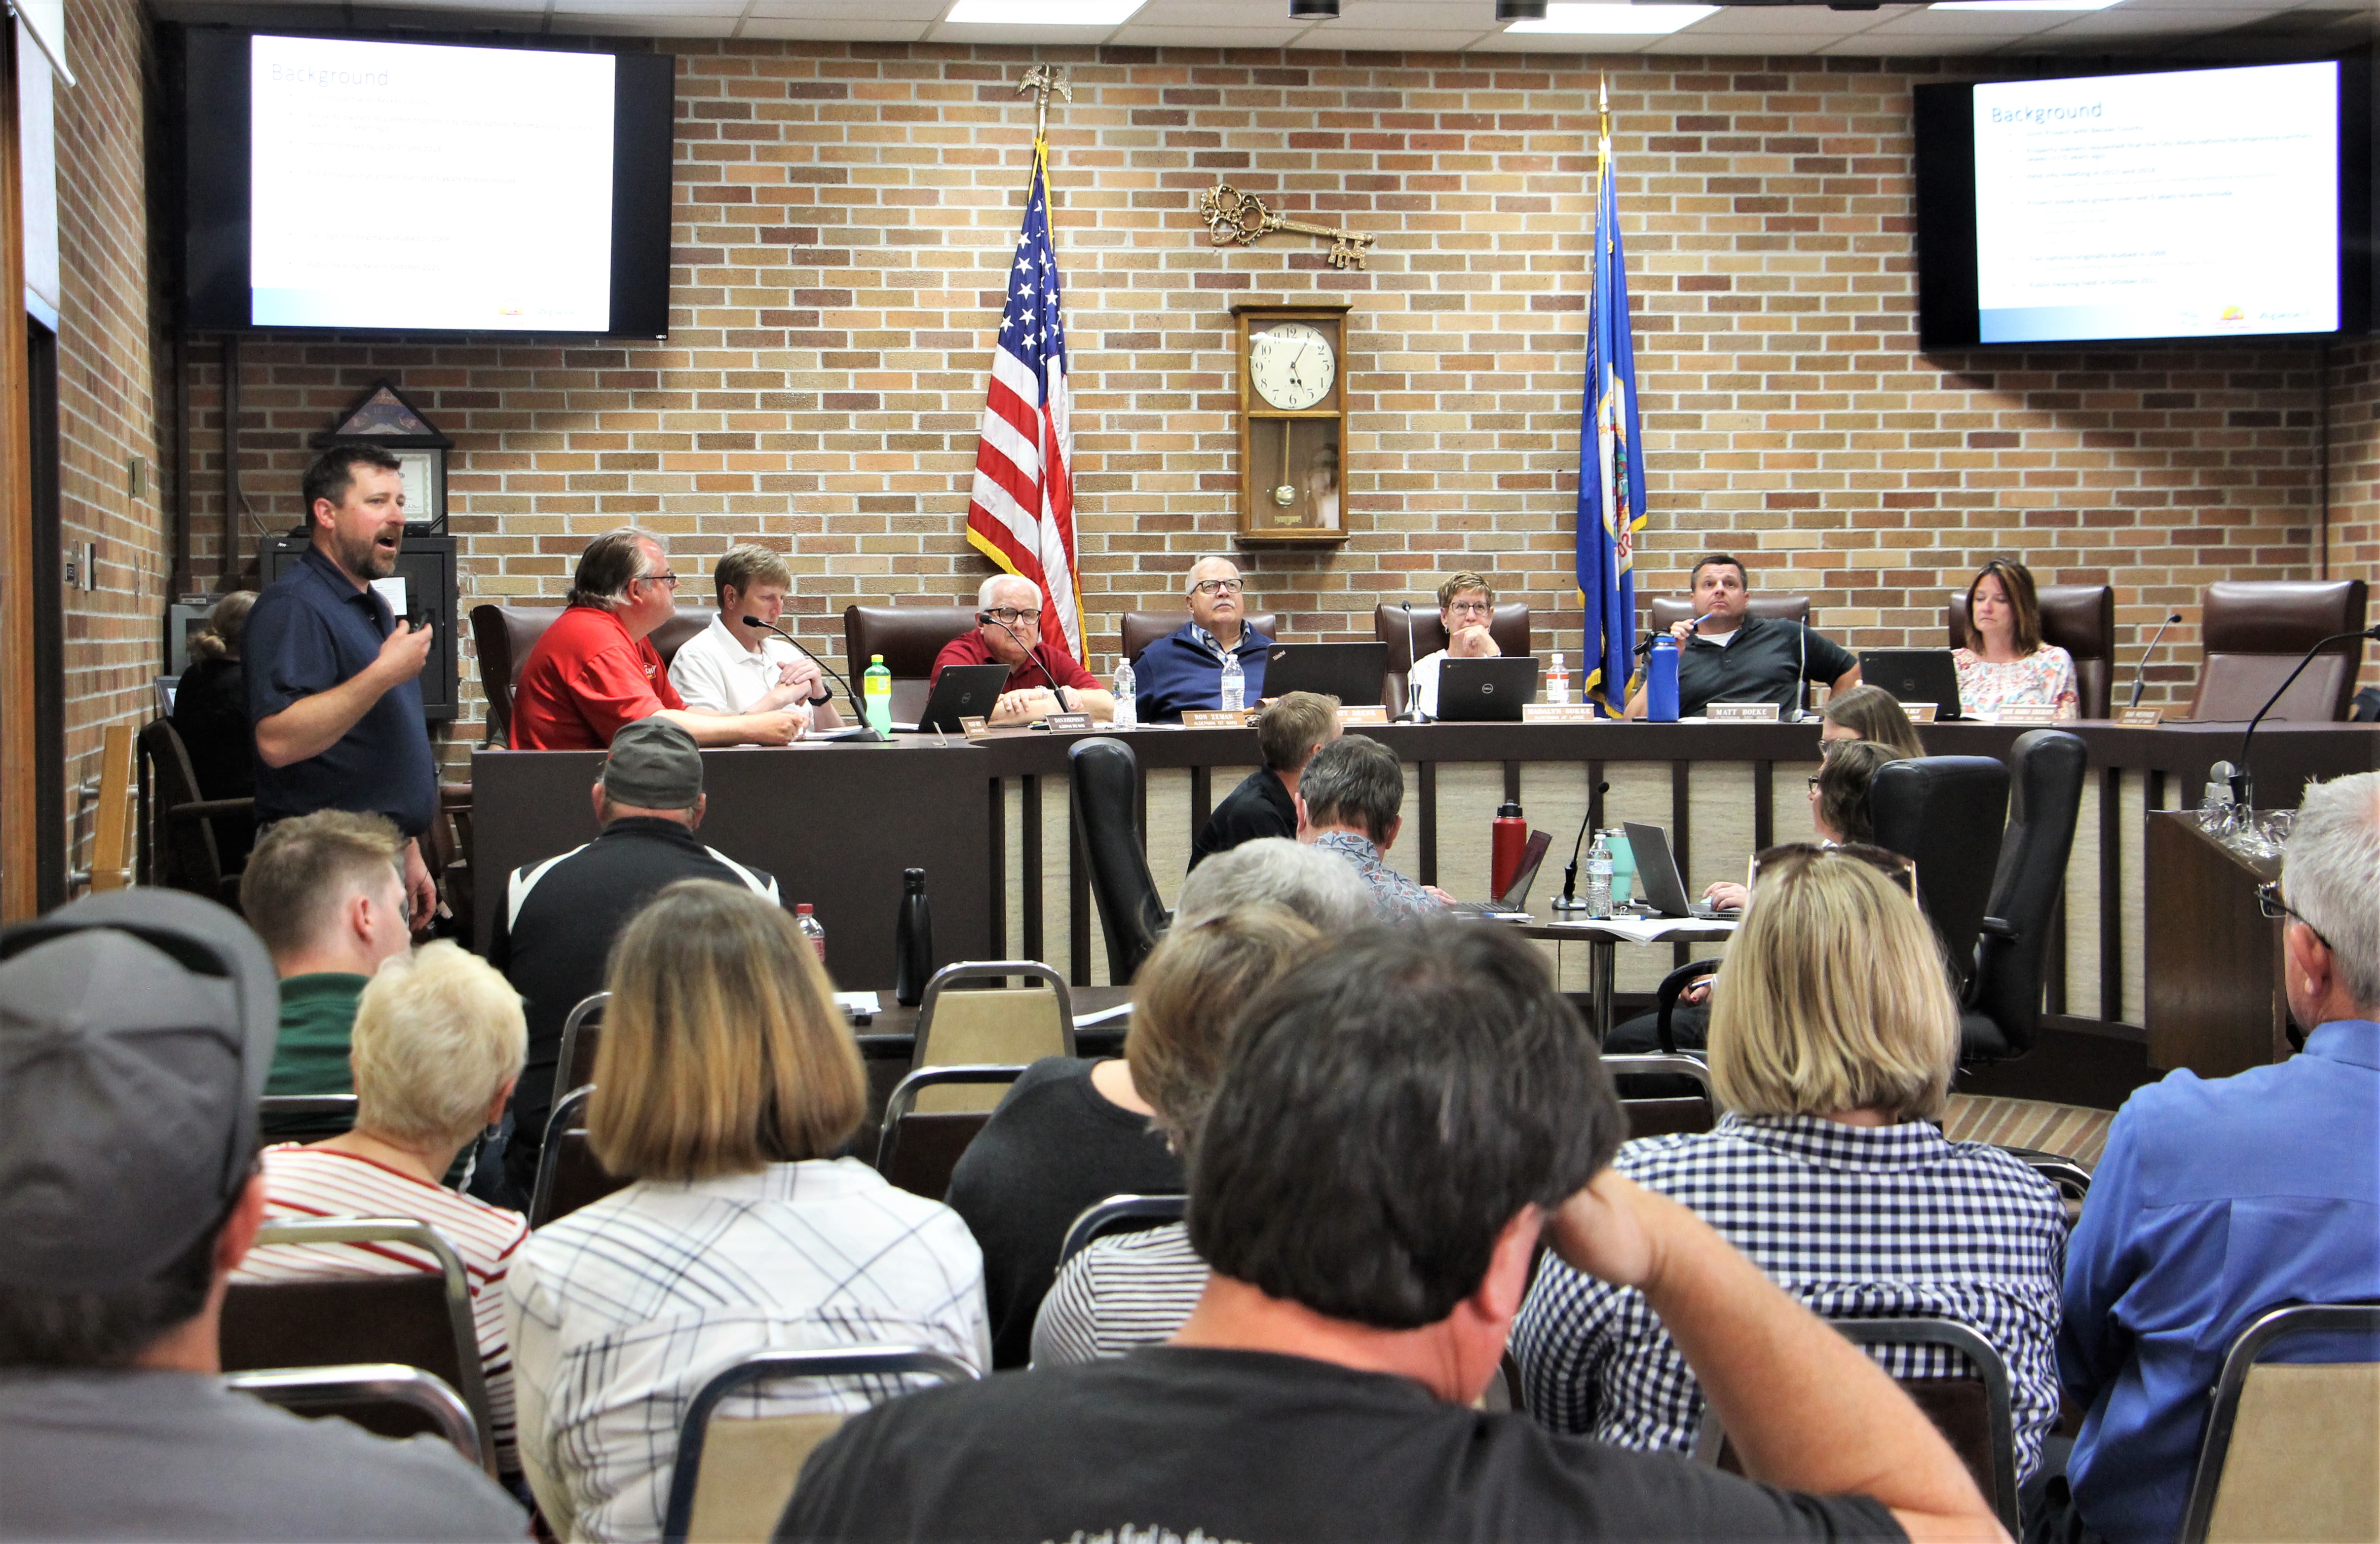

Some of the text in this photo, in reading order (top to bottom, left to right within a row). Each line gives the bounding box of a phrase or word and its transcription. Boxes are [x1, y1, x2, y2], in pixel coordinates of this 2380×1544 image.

[272, 63, 388, 87] Background
[1992, 101, 2102, 125] Background
[1274, 332, 1280, 344] 11
[1286, 328, 1297, 339] 12
[1261, 344, 1272, 356] 10
[1317, 345, 1324, 355] 2
[1255, 361, 1263, 373] 9
[1322, 360, 1330, 372] 3
[1260, 377, 1268, 389] 8
[1272, 389, 1280, 401] 7
[1289, 394, 1297, 405] 6
[1307, 388, 1315, 400] 5
[1272, 650, 1286, 661] ThinkPad
